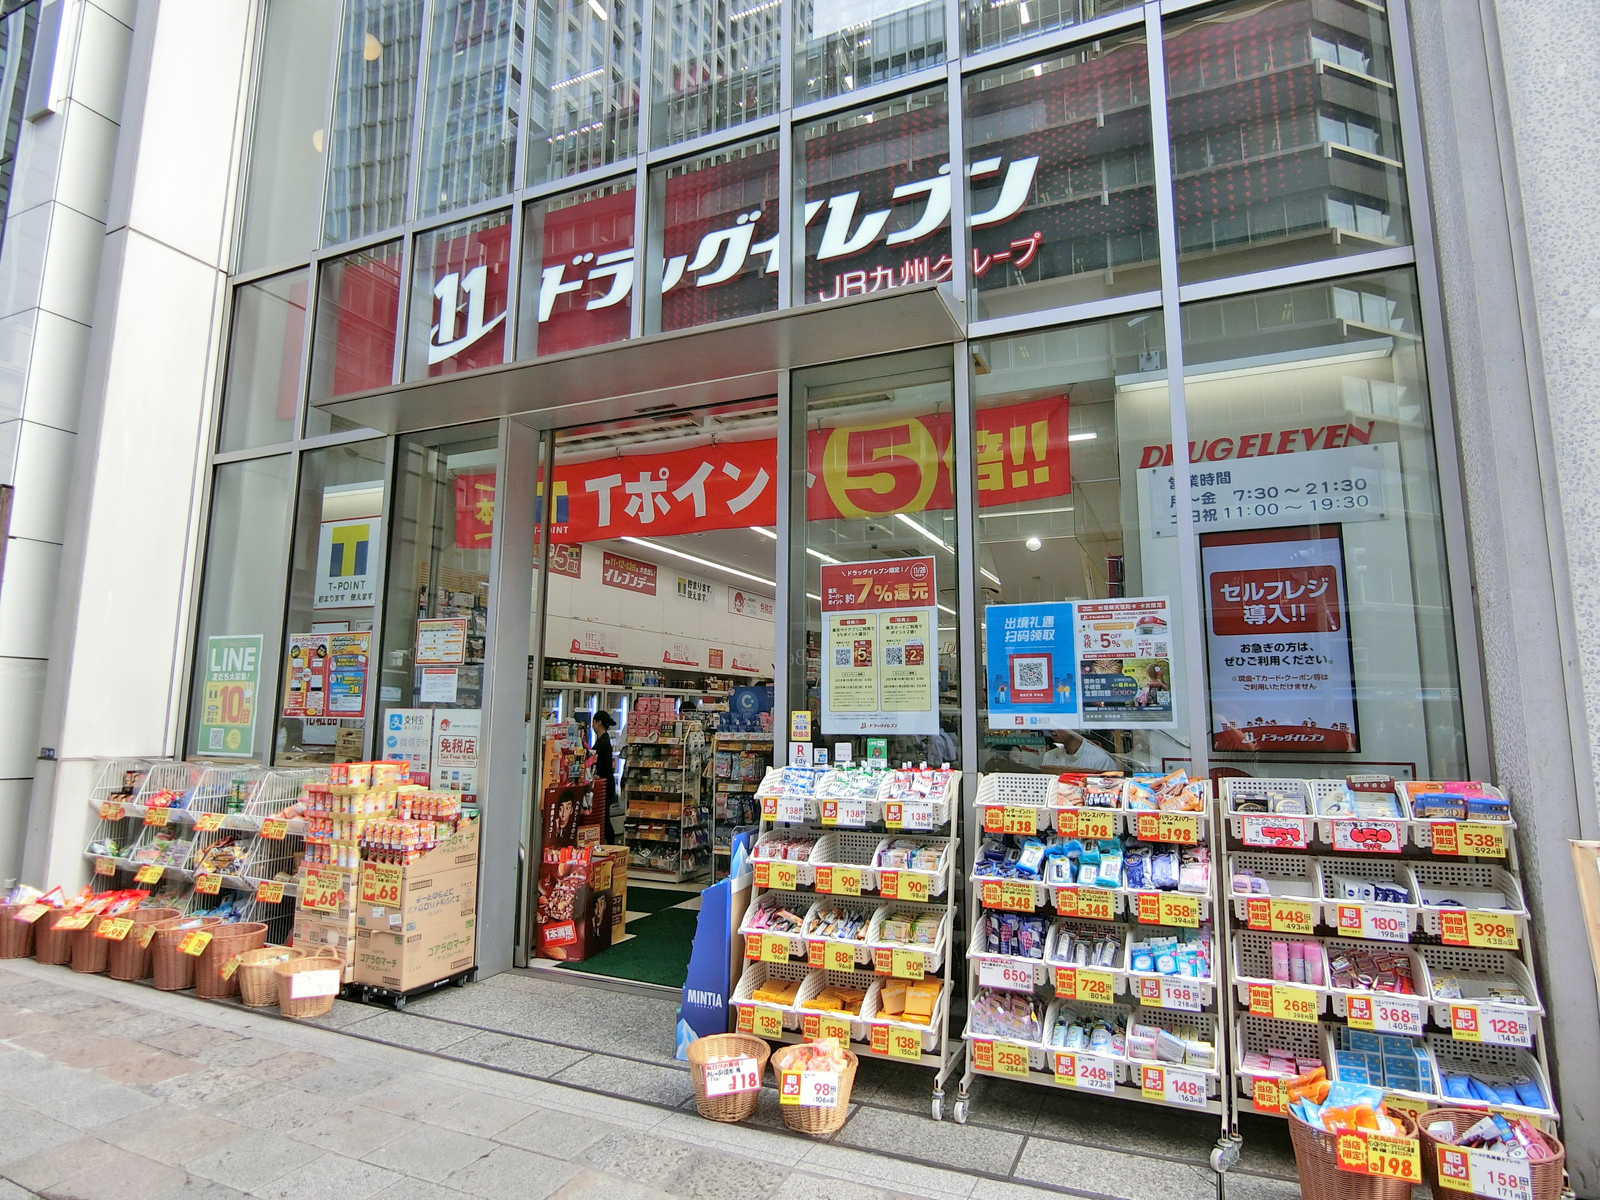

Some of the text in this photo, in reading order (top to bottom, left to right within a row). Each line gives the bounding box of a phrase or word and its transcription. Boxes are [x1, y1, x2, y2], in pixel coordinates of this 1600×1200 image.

[1237, 420, 1375, 459] ELEVEN
[604, 569, 655, 588] イレブンデー
[328, 581, 366, 592] T-POINT
[1219, 577, 1329, 603] セルフレジ
[351, 592, 373, 601] 使えます
[1243, 603, 1307, 627] 導入!!
[1004, 615, 1055, 630] 出境礼遇
[1004, 629, 1056, 643] 扫码领取
[1240, 641, 1316, 655] お急ぎの方は、
[211, 647, 256, 672] LINE
[1224, 655, 1334, 667] ぜひご利用ください。
[1261, 733, 1325, 742] ドラッグイレブン
[440, 738, 475, 754] 免税店
[795, 758, 807, 766] Edy
[784, 806, 800, 815] 138
[845, 809, 860, 818] 138
[911, 812, 926, 821] 138
[1078, 811, 1110, 819] バランスパワー
[1010, 820, 1032, 830] 138
[1085, 825, 1108, 836] 198
[1166, 828, 1192, 841] 198
[1463, 833, 1494, 847] 538
[778, 871, 791, 882] 90
[841, 876, 855, 886] 90
[908, 881, 921, 892] 90
[319, 890, 337, 907] 68
[380, 885, 399, 902] 68
[1009, 896, 1030, 908] 348
[1086, 903, 1109, 916] 348
[1165, 904, 1190, 917] 358
[1274, 909, 1304, 923] 448
[1370, 917, 1398, 931] 180
[1473, 922, 1506, 937] 398
[427, 936, 471, 958] コアラのマーチ
[771, 943, 783, 955] 88
[360, 953, 398, 968] コアラのマーチ
[835, 952, 848, 963] 88
[906, 960, 918, 970] 90
[1003, 969, 1027, 983] 650
[1080, 979, 1106, 992] 728
[687, 989, 723, 1009] MINTIA
[1165, 987, 1191, 1000] 198
[1284, 999, 1309, 1012] 268
[1380, 1008, 1411, 1022] 368
[759, 1016, 777, 1028] 138
[1488, 1019, 1518, 1035] 128
[825, 1026, 843, 1038] 138
[895, 1036, 914, 1048] 138
[998, 1051, 1021, 1065] 258
[1080, 1065, 1105, 1080] 248
[731, 1072, 757, 1090] 118
[813, 1083, 830, 1096] 98
[1172, 1080, 1198, 1096] 148
[1342, 1138, 1361, 1149] 当店
[1378, 1156, 1413, 1176] 198
[1487, 1170, 1518, 1188] 158
